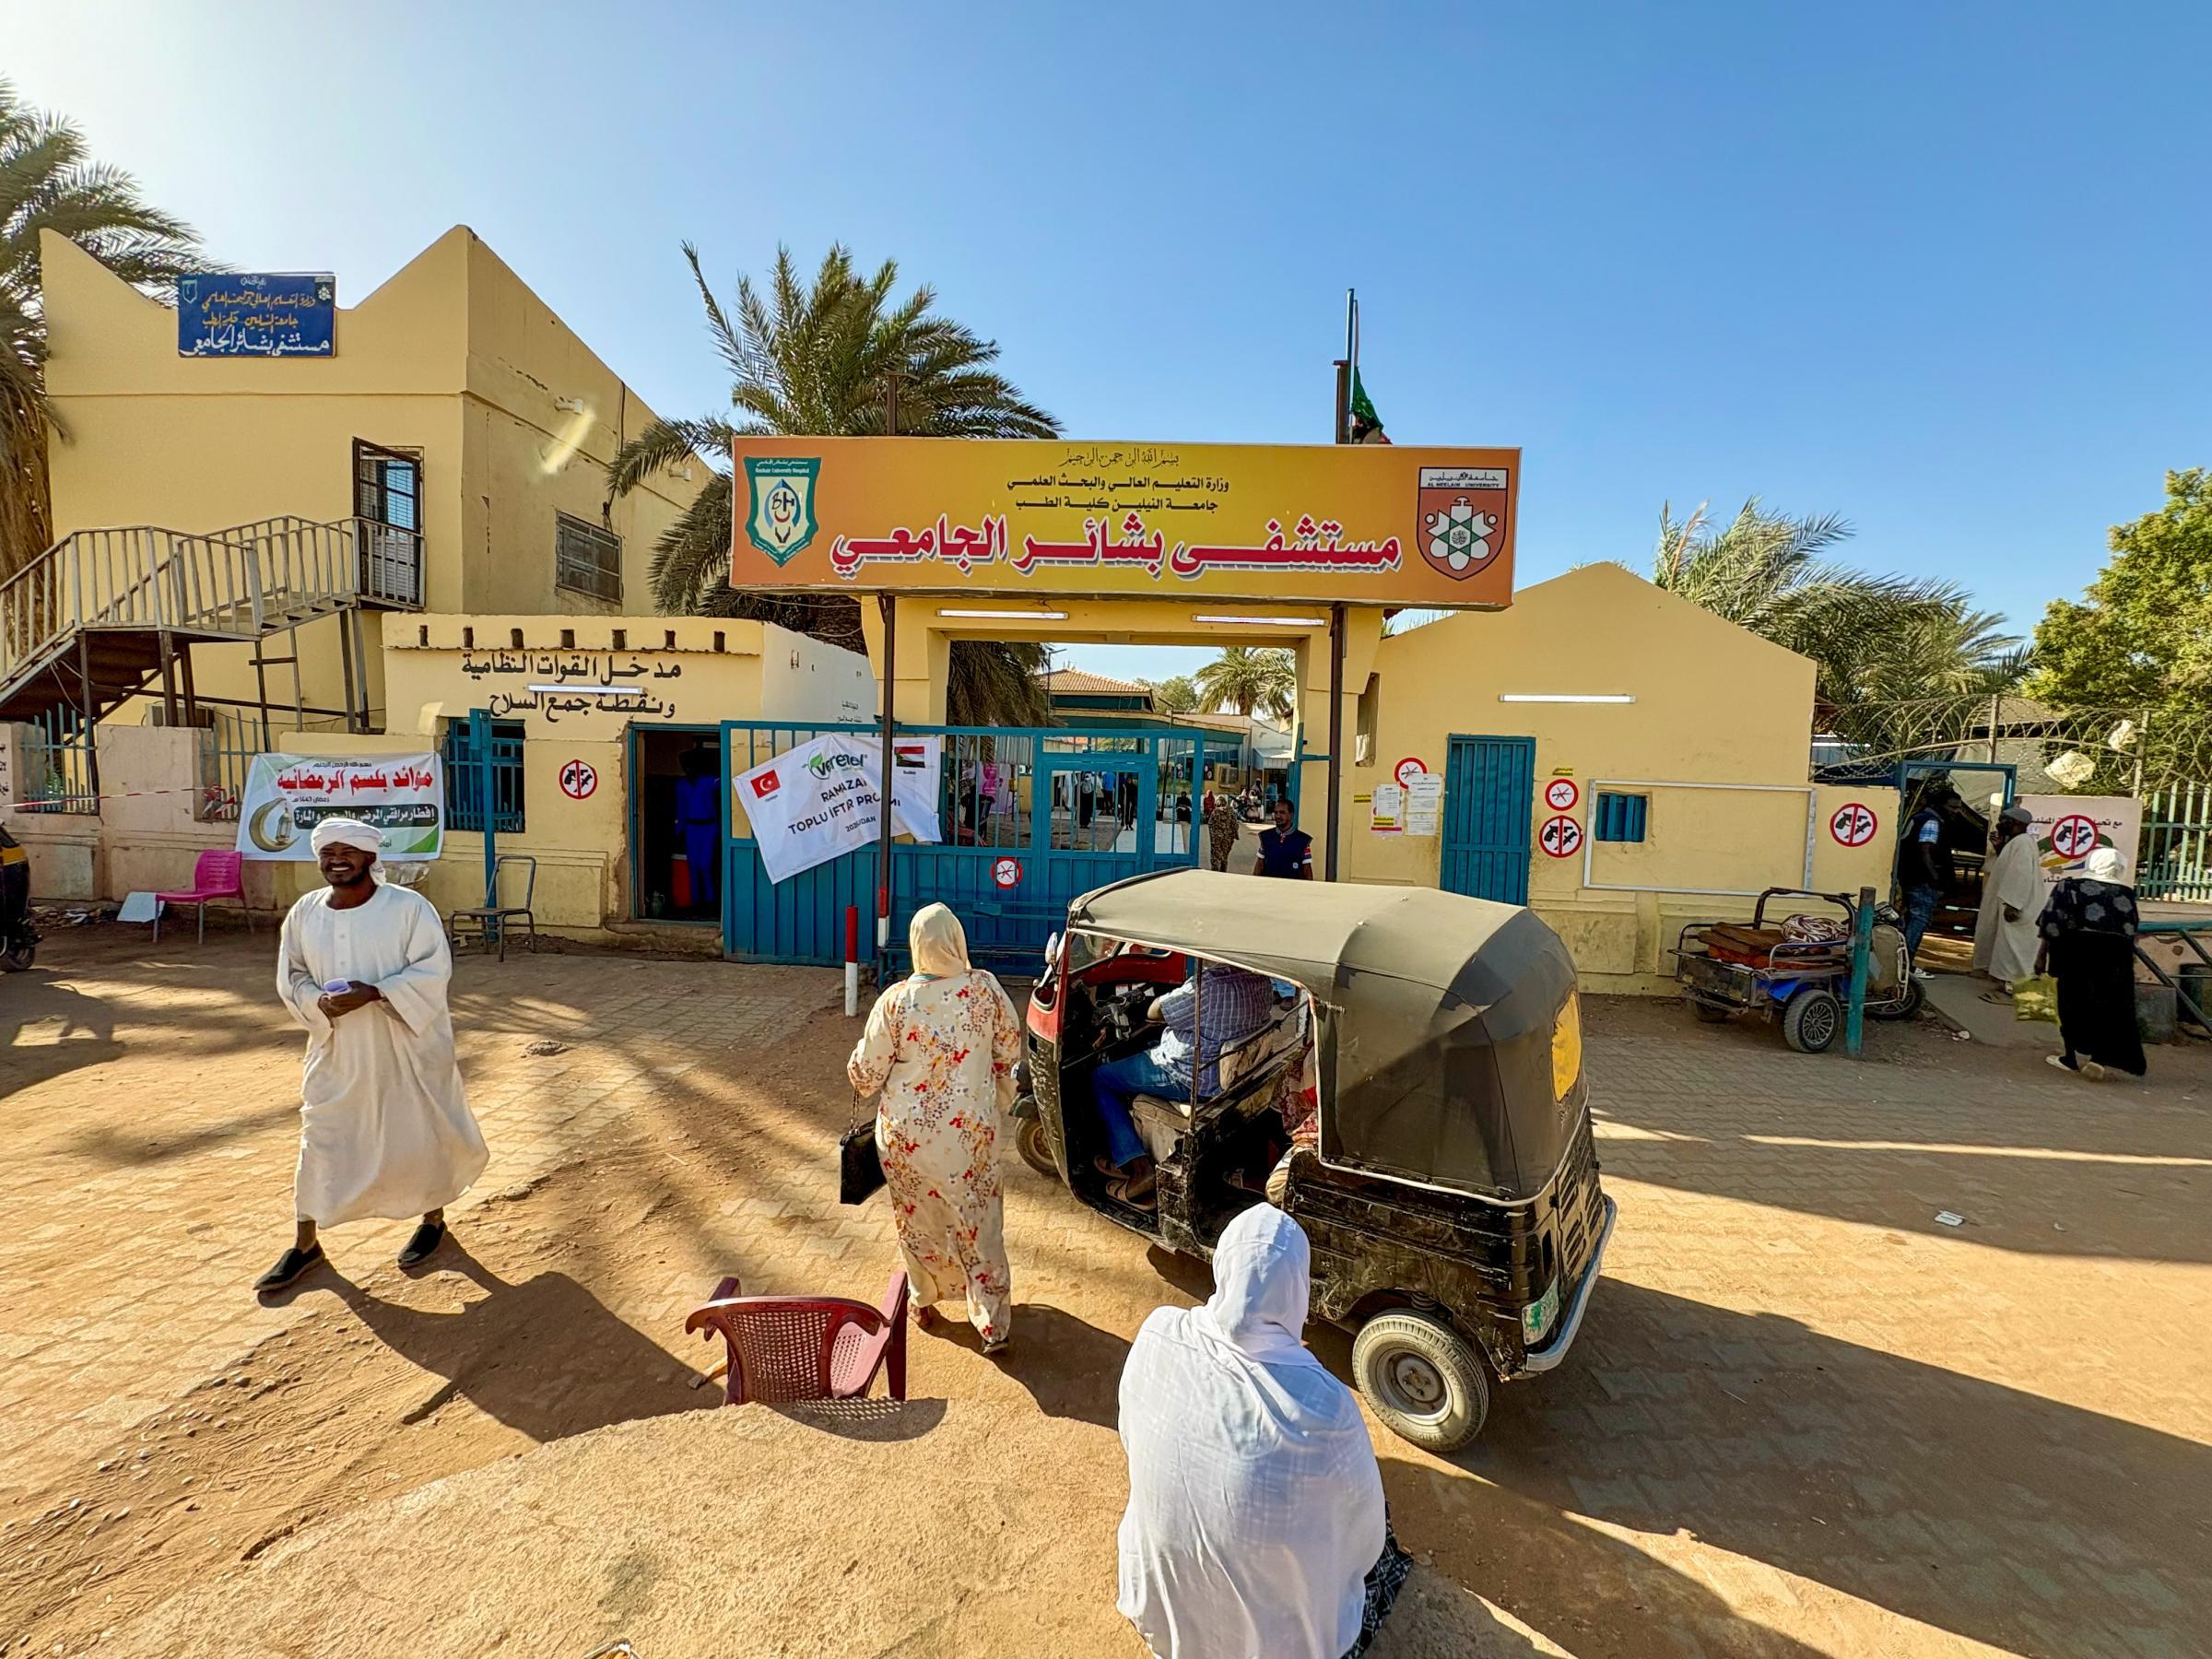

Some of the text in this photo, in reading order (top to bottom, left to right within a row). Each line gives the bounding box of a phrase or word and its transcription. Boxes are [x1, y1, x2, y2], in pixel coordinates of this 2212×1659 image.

[229, 327, 274, 355] بشائر
[1006, 472, 1230, 493] وزارة التعليم العالي والبحث العلمي
[1016, 496, 1218, 514] جامعة النيلين كلية الطب
[830, 511, 1402, 580] مستشفى بشائر الجامعي
[461, 652, 533, 680] النظامية
[536, 653, 597, 683] القوات
[488, 691, 545, 716] السلاح
[546, 696, 592, 723] جمع
[277, 766, 433, 795] موائد بلسم الرمضانية
[408, 806, 435, 821] إفطار
[788, 811, 829, 835] TOPLU
